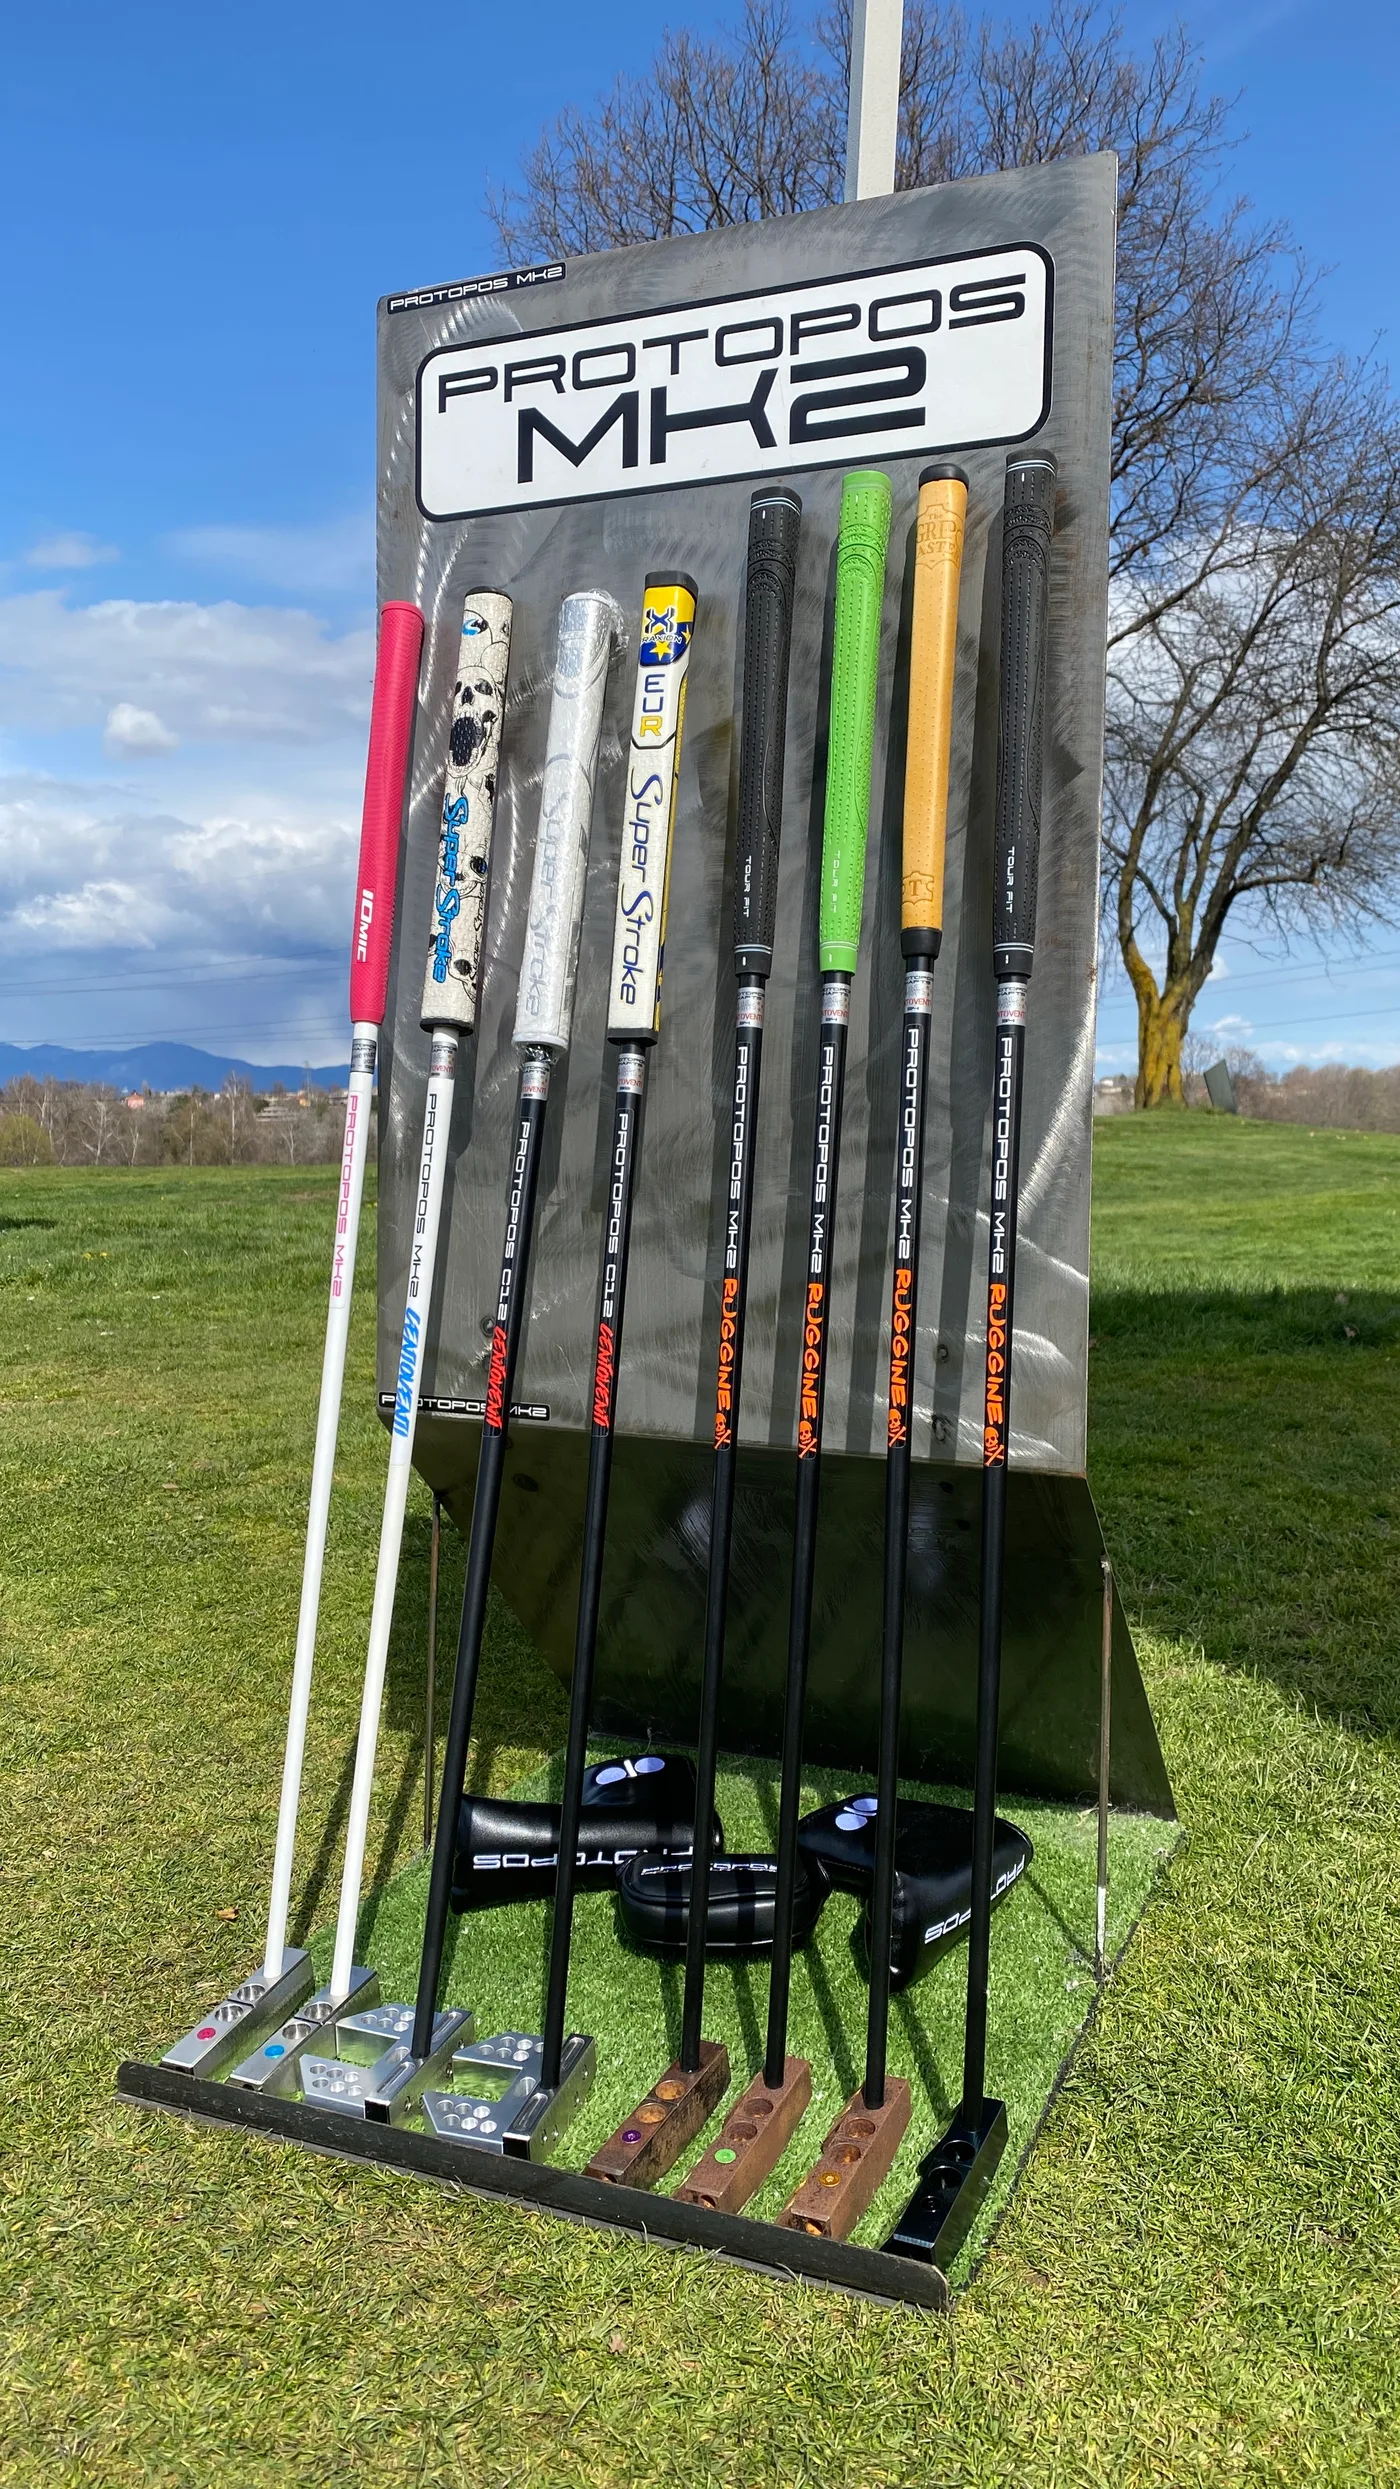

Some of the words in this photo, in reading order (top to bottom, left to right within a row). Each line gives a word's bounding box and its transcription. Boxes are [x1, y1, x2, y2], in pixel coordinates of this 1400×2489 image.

[390, 277, 509, 311] PROTOPOS
[516, 266, 563, 285] MK2
[437, 273, 1027, 413] PROTOPOS
[517, 345, 927, 484] MK2
[445, 793, 469, 888] Super
[540, 792, 574, 900] Super
[629, 767, 664, 883] Super
[744, 855, 752, 894] TOUR
[832, 850, 841, 887] TOUR
[1006, 846, 1016, 887] TOUR
[356, 888, 374, 963] IOMIC
[433, 883, 461, 984] Stroke
[620, 883, 654, 1006] Stroke
[742, 899, 750, 918] FIT
[830, 892, 838, 914] FIT
[1005, 892, 1014, 914] FIT
[730, 1046, 749, 1200] PROTOPOS
[816, 1046, 834, 1203] PROTOPOS
[902, 1028, 920, 1188] PROTOPOS
[995, 1037, 1013, 1202] PROTOPOS
[338, 1094, 359, 1235] PROTOPOS
[416, 1093, 437, 1235] PROTOPOS
[505, 1121, 530, 1259] PROTOPOS
[608, 1113, 629, 1254] PROTOPOS
[331, 1245, 345, 1298] MK2
[408, 1245, 423, 1298] MK2
[726, 1210, 740, 1269] MK2
[810, 1214, 825, 1274] MK2
[898, 1199, 912, 1260] MK2
[992, 1211, 1006, 1274] MK2
[717, 1278, 738, 1411] RUGGINE
[802, 1283, 823, 1419] RUGGINE
[890, 1268, 912, 1407] RUGGINE
[986, 1283, 1006, 1424] RUGGINE
[381, 1394, 486, 1413] PTOPO
[924, 1854, 1026, 1945] PROPOS
